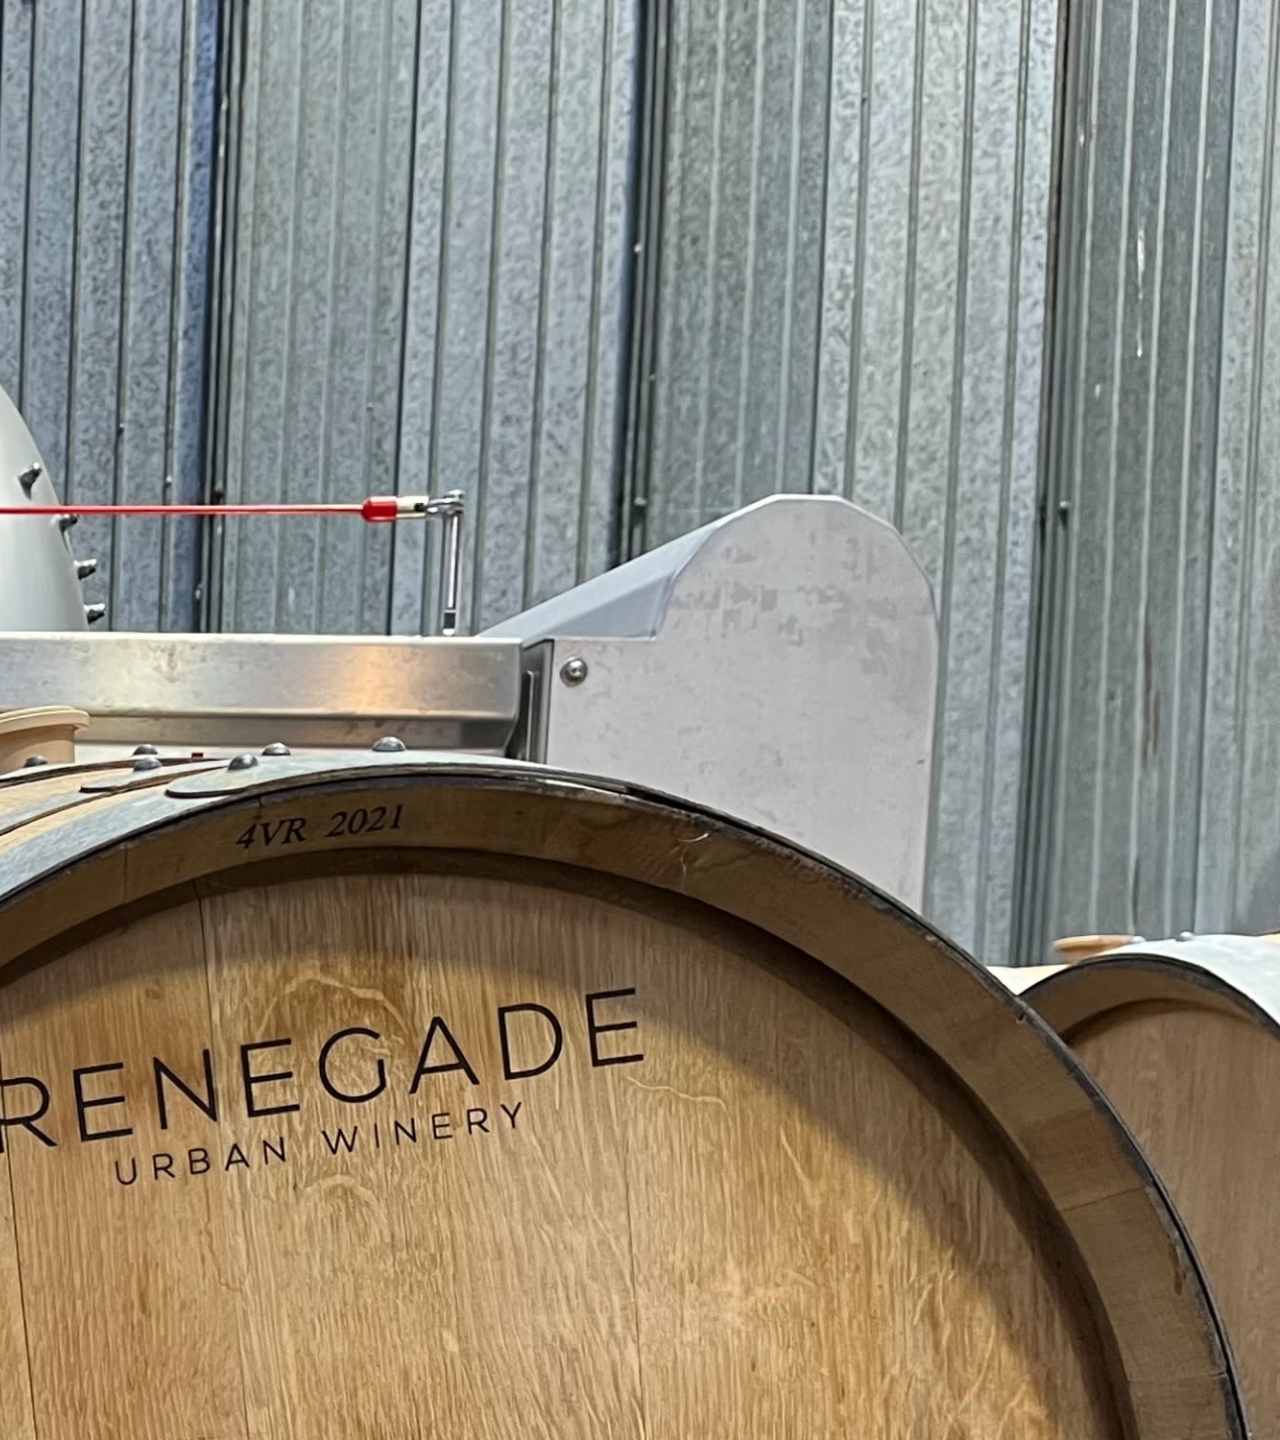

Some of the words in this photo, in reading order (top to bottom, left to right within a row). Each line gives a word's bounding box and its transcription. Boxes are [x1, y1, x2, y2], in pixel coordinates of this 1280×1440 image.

[235, 817, 307, 849] 4VR
[324, 804, 405, 838] 2021
[114, 1136, 286, 1186] URBAN
[321, 1101, 523, 1156] WINERY
